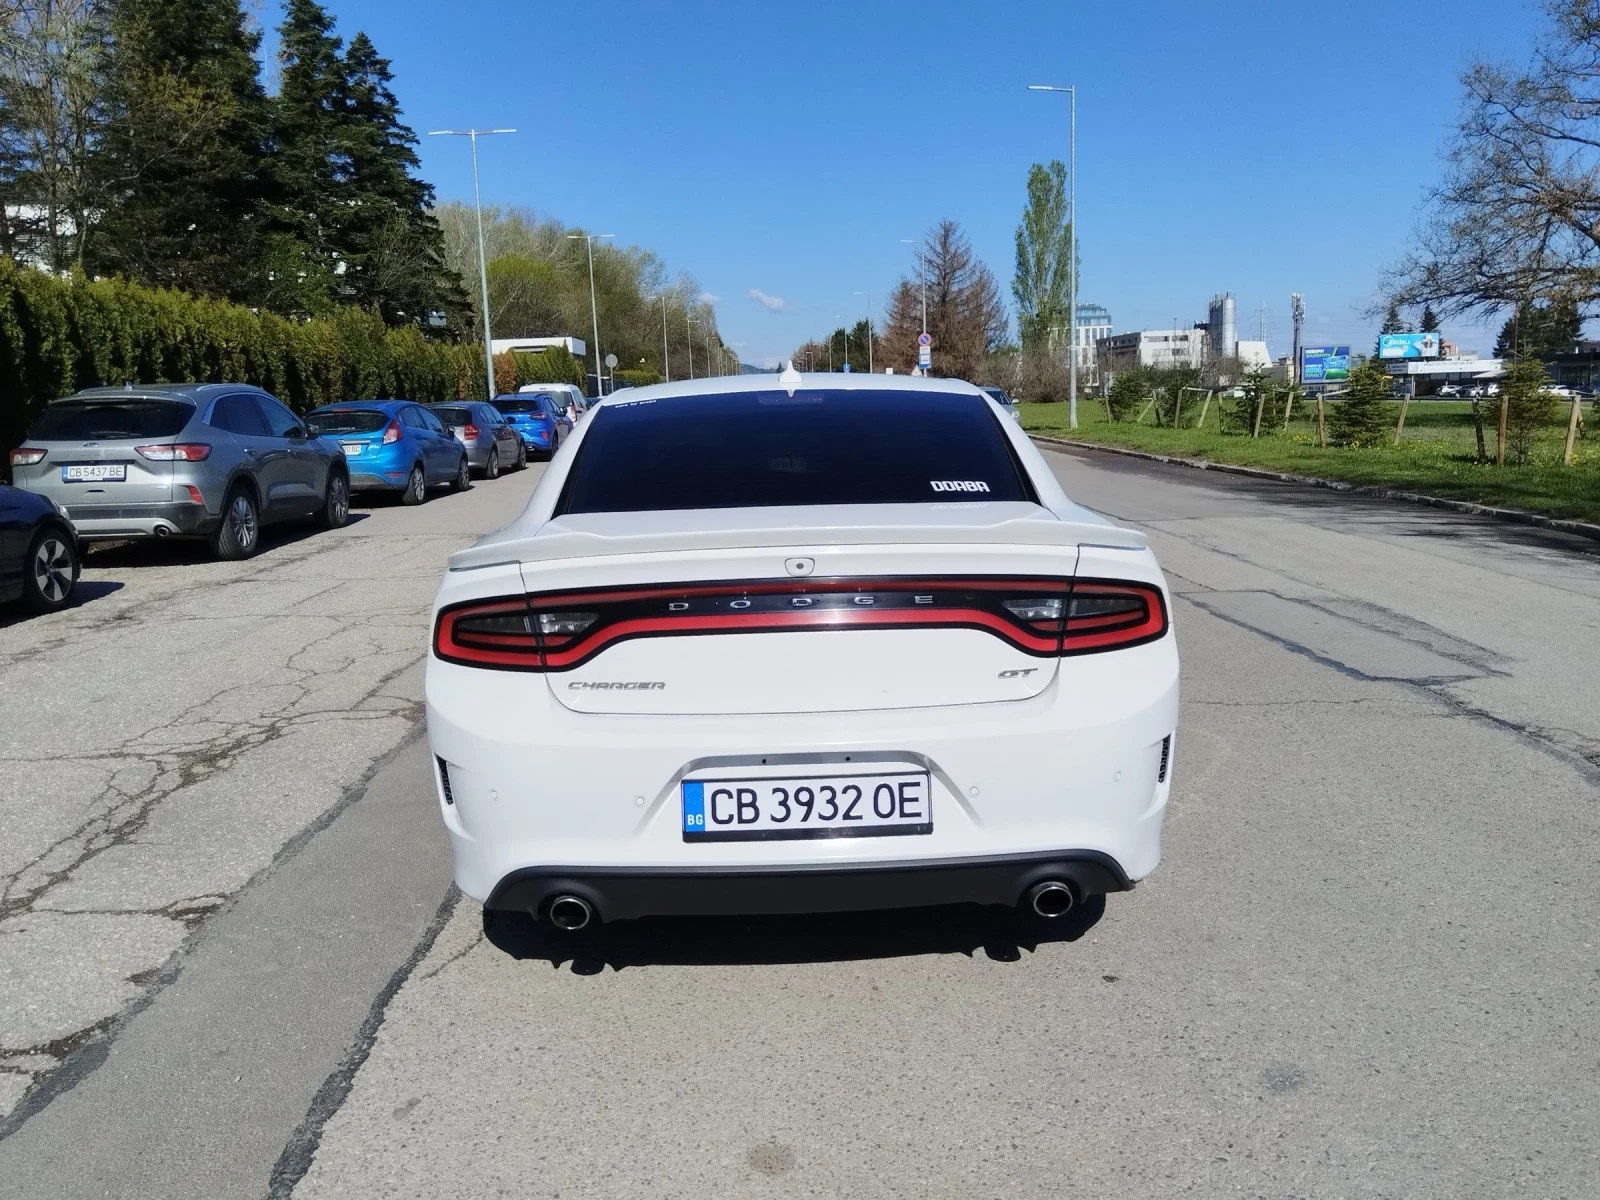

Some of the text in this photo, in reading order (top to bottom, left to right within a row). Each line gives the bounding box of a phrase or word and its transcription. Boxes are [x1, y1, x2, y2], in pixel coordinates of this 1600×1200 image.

[352, 445, 360, 453] BC
[69, 467, 82, 478] CB
[83, 466, 108, 477] 5437
[109, 466, 123, 477] BE
[930, 480, 991, 492] DOABA
[668, 595, 935, 611] DODGE
[998, 667, 1039, 680] GT
[568, 681, 667, 691] CHARGER
[687, 781, 922, 826] BG CB 3932 OE
